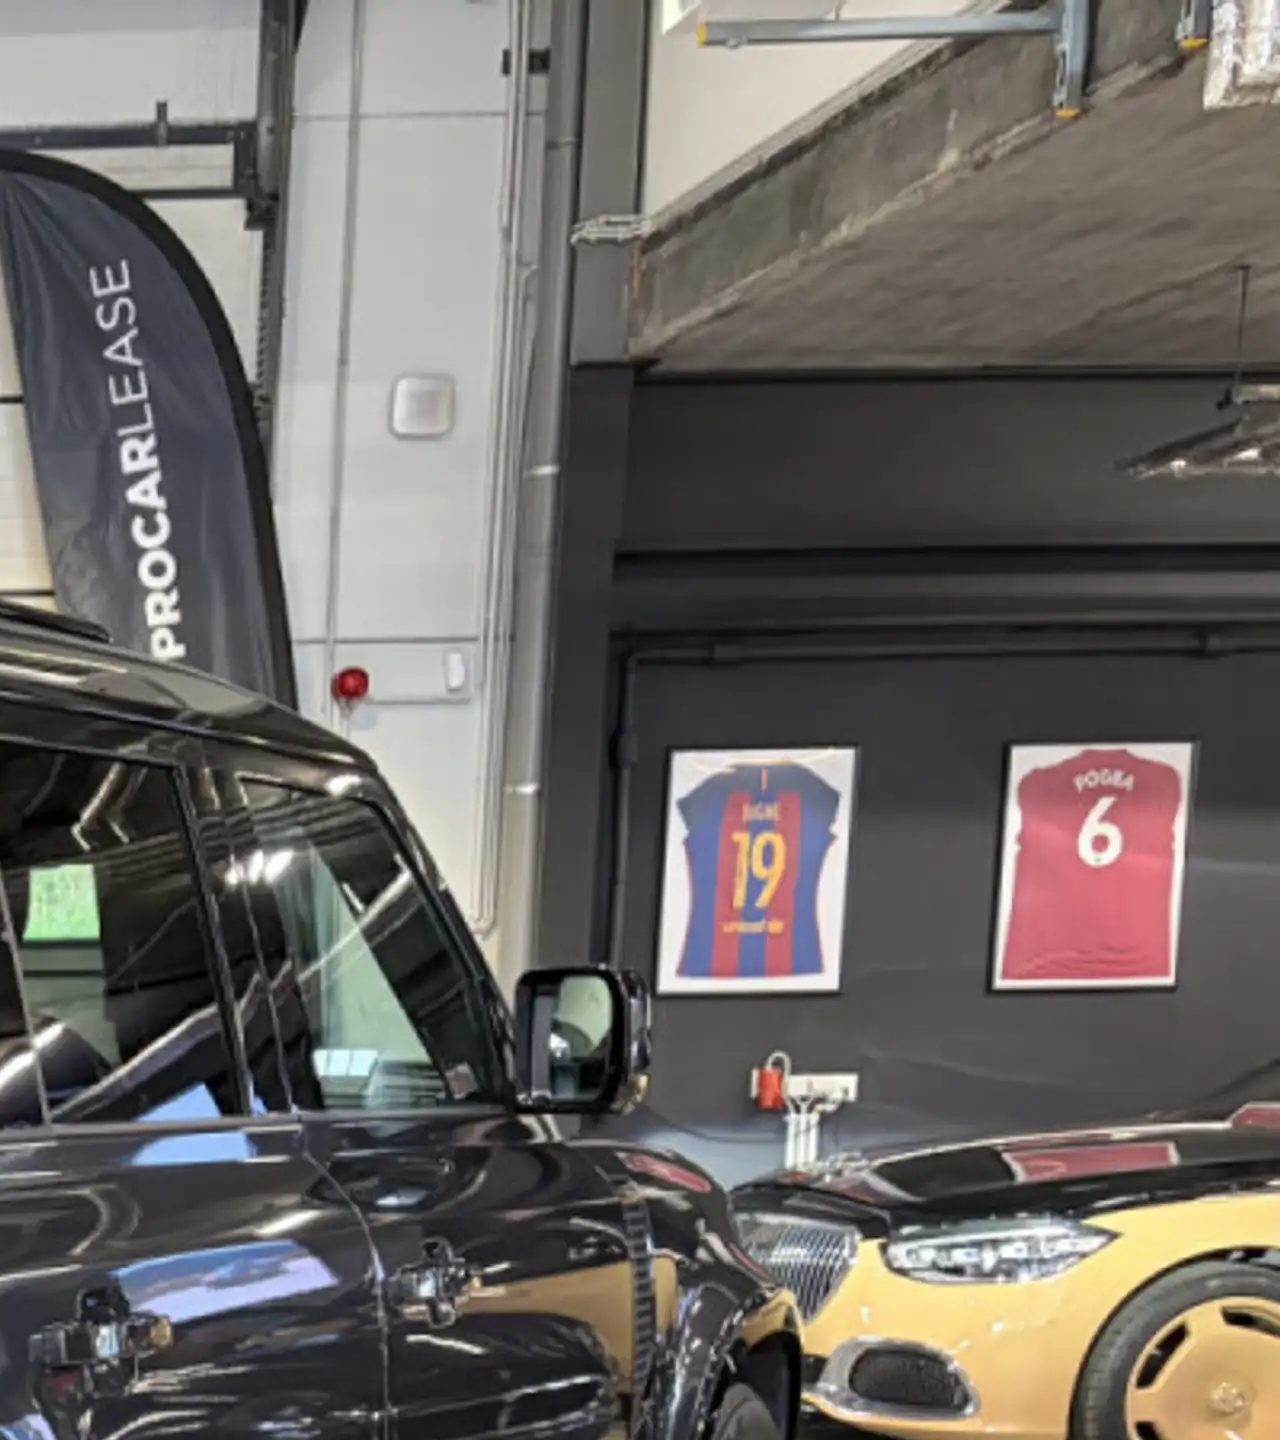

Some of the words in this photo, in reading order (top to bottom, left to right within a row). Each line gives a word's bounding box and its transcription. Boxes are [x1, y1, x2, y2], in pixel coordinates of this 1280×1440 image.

[89, 258, 186, 663] PROCARLEASE
[1072, 768, 1135, 792] POGBA
[1077, 796, 1124, 868] 6
[731, 831, 787, 908] 19
